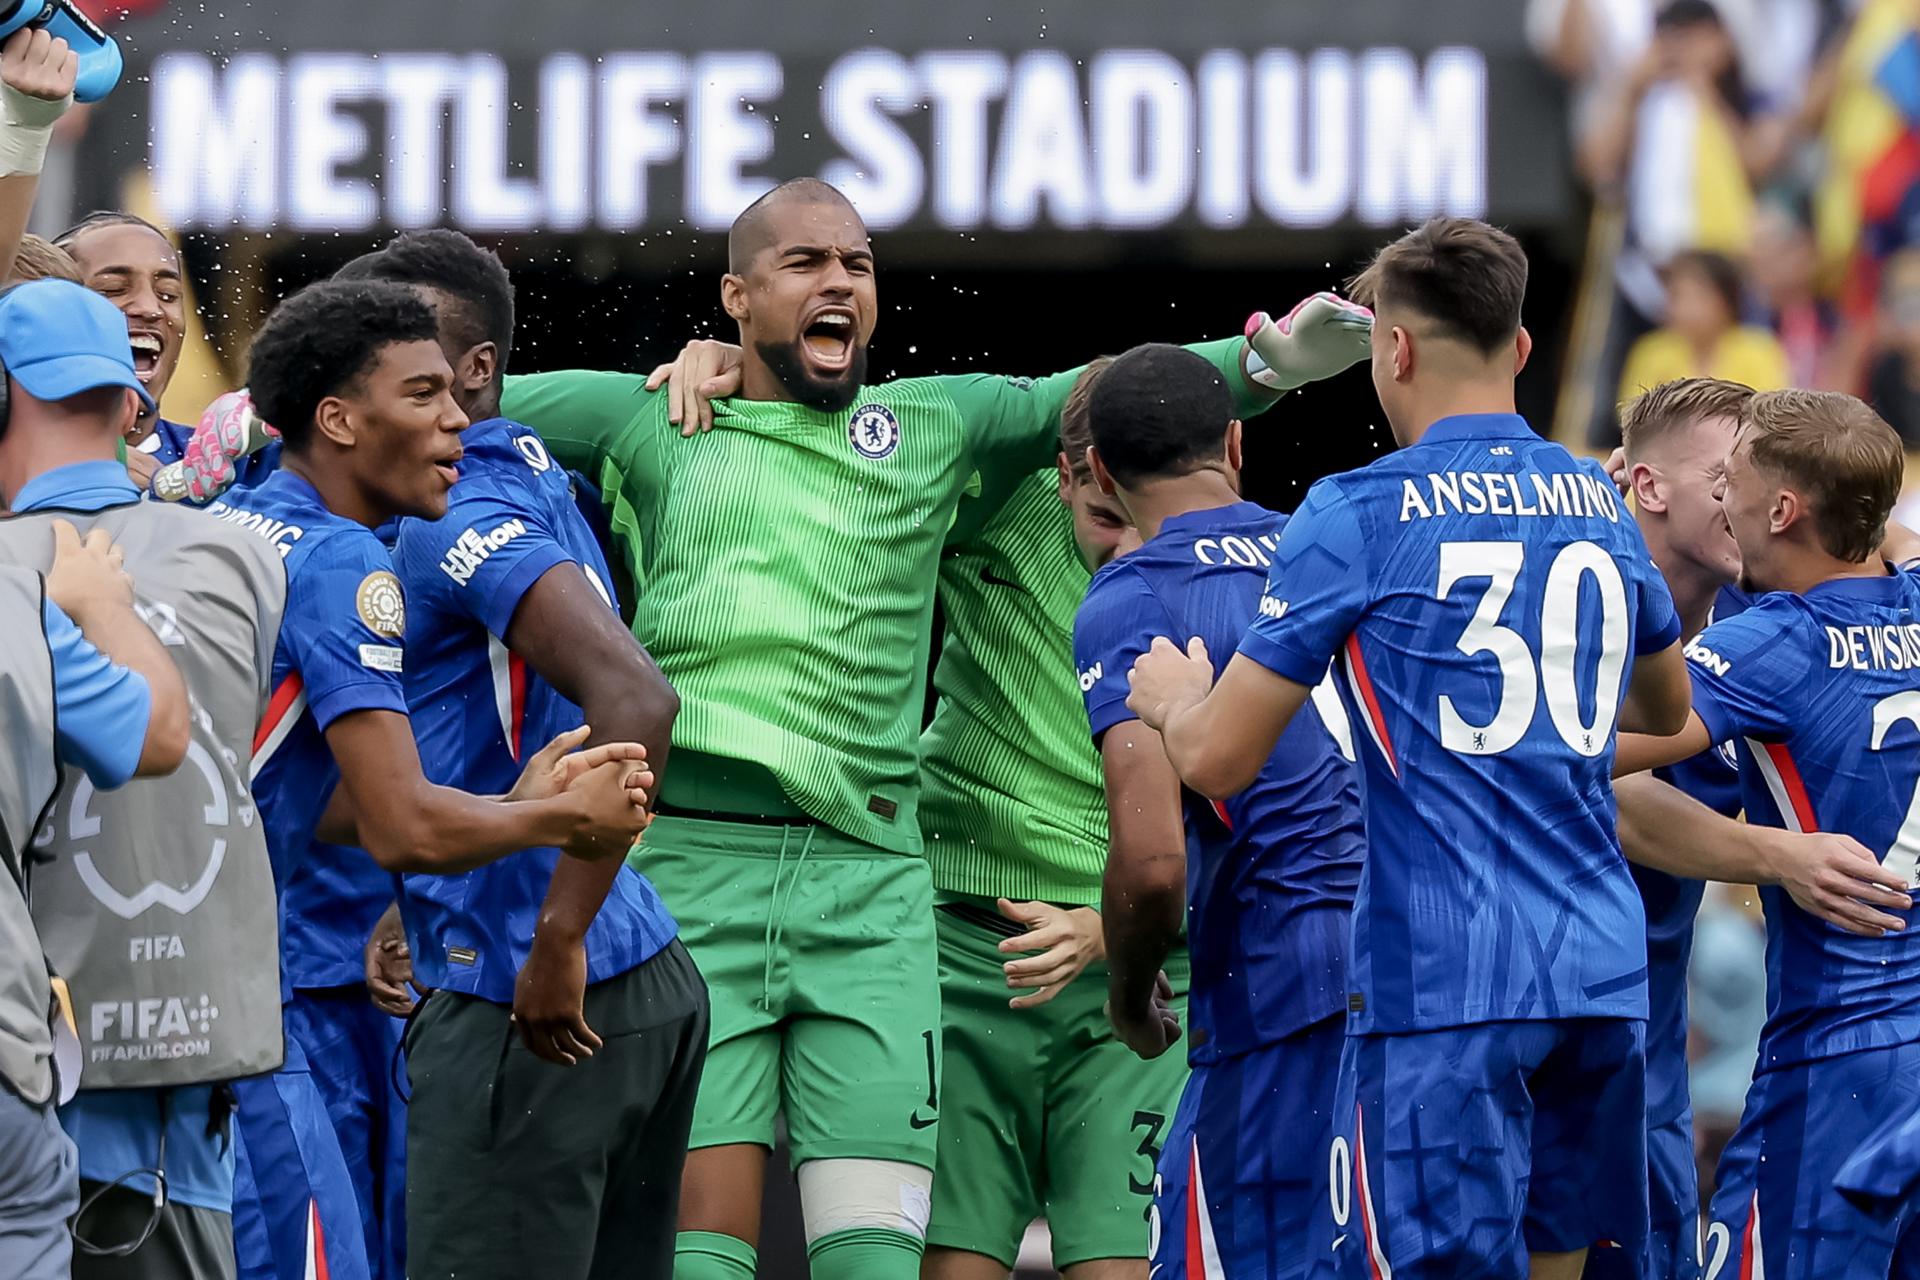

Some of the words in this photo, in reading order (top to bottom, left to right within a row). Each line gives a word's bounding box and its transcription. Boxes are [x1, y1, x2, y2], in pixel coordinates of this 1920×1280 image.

[150, 51, 784, 232] METLIFE
[818, 45, 1488, 229] STADIUM
[855, 405, 889, 418] CHELSEA
[1399, 471, 1619, 523] ANSELMINO
[451, 518, 527, 587] NATION
[1437, 541, 1629, 757] 30
[130, 935, 186, 962] FIFA
[91, 1039, 211, 1063] FIFAPLUS.COM
